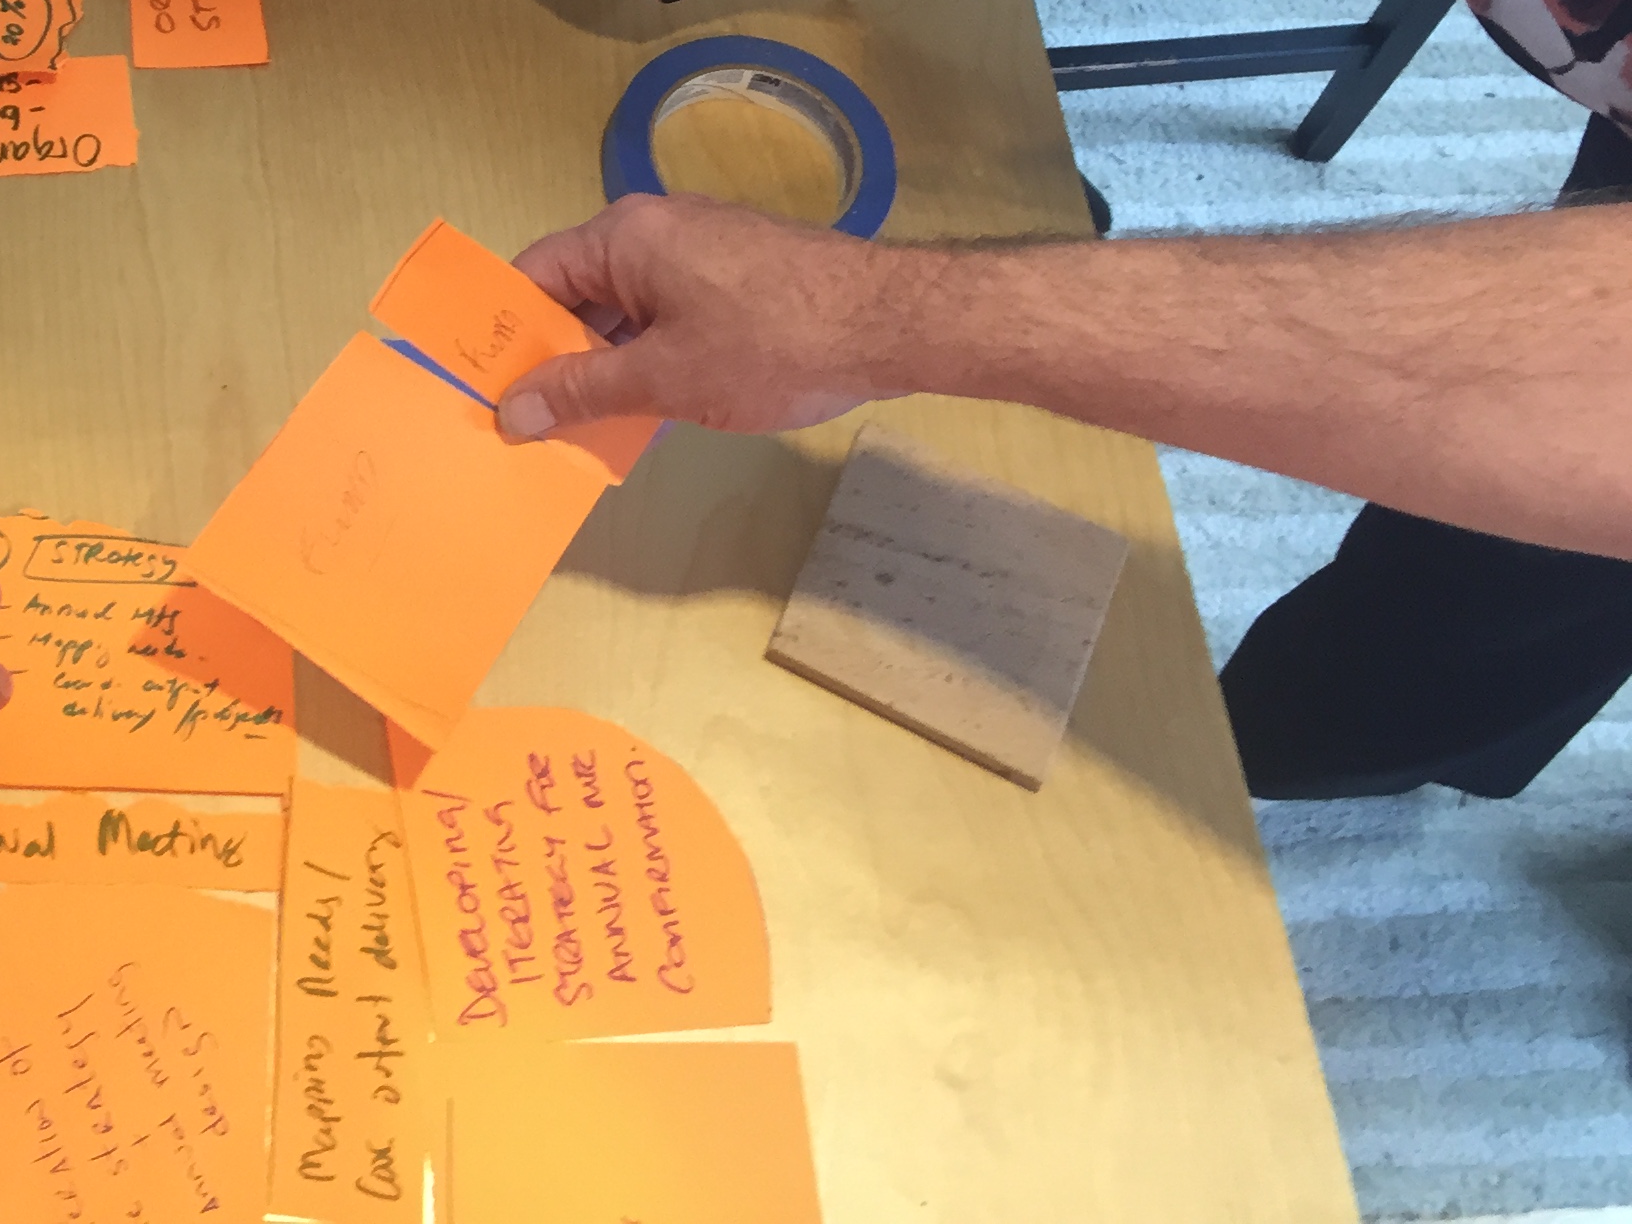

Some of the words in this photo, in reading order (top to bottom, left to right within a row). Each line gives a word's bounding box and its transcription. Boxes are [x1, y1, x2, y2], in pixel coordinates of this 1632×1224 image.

[97, 809, 248, 869] Meeting
[359, 830, 402, 970] delivery
[584, 823, 637, 983] ANNUAL
[543, 836, 594, 1007] STRATEGY
